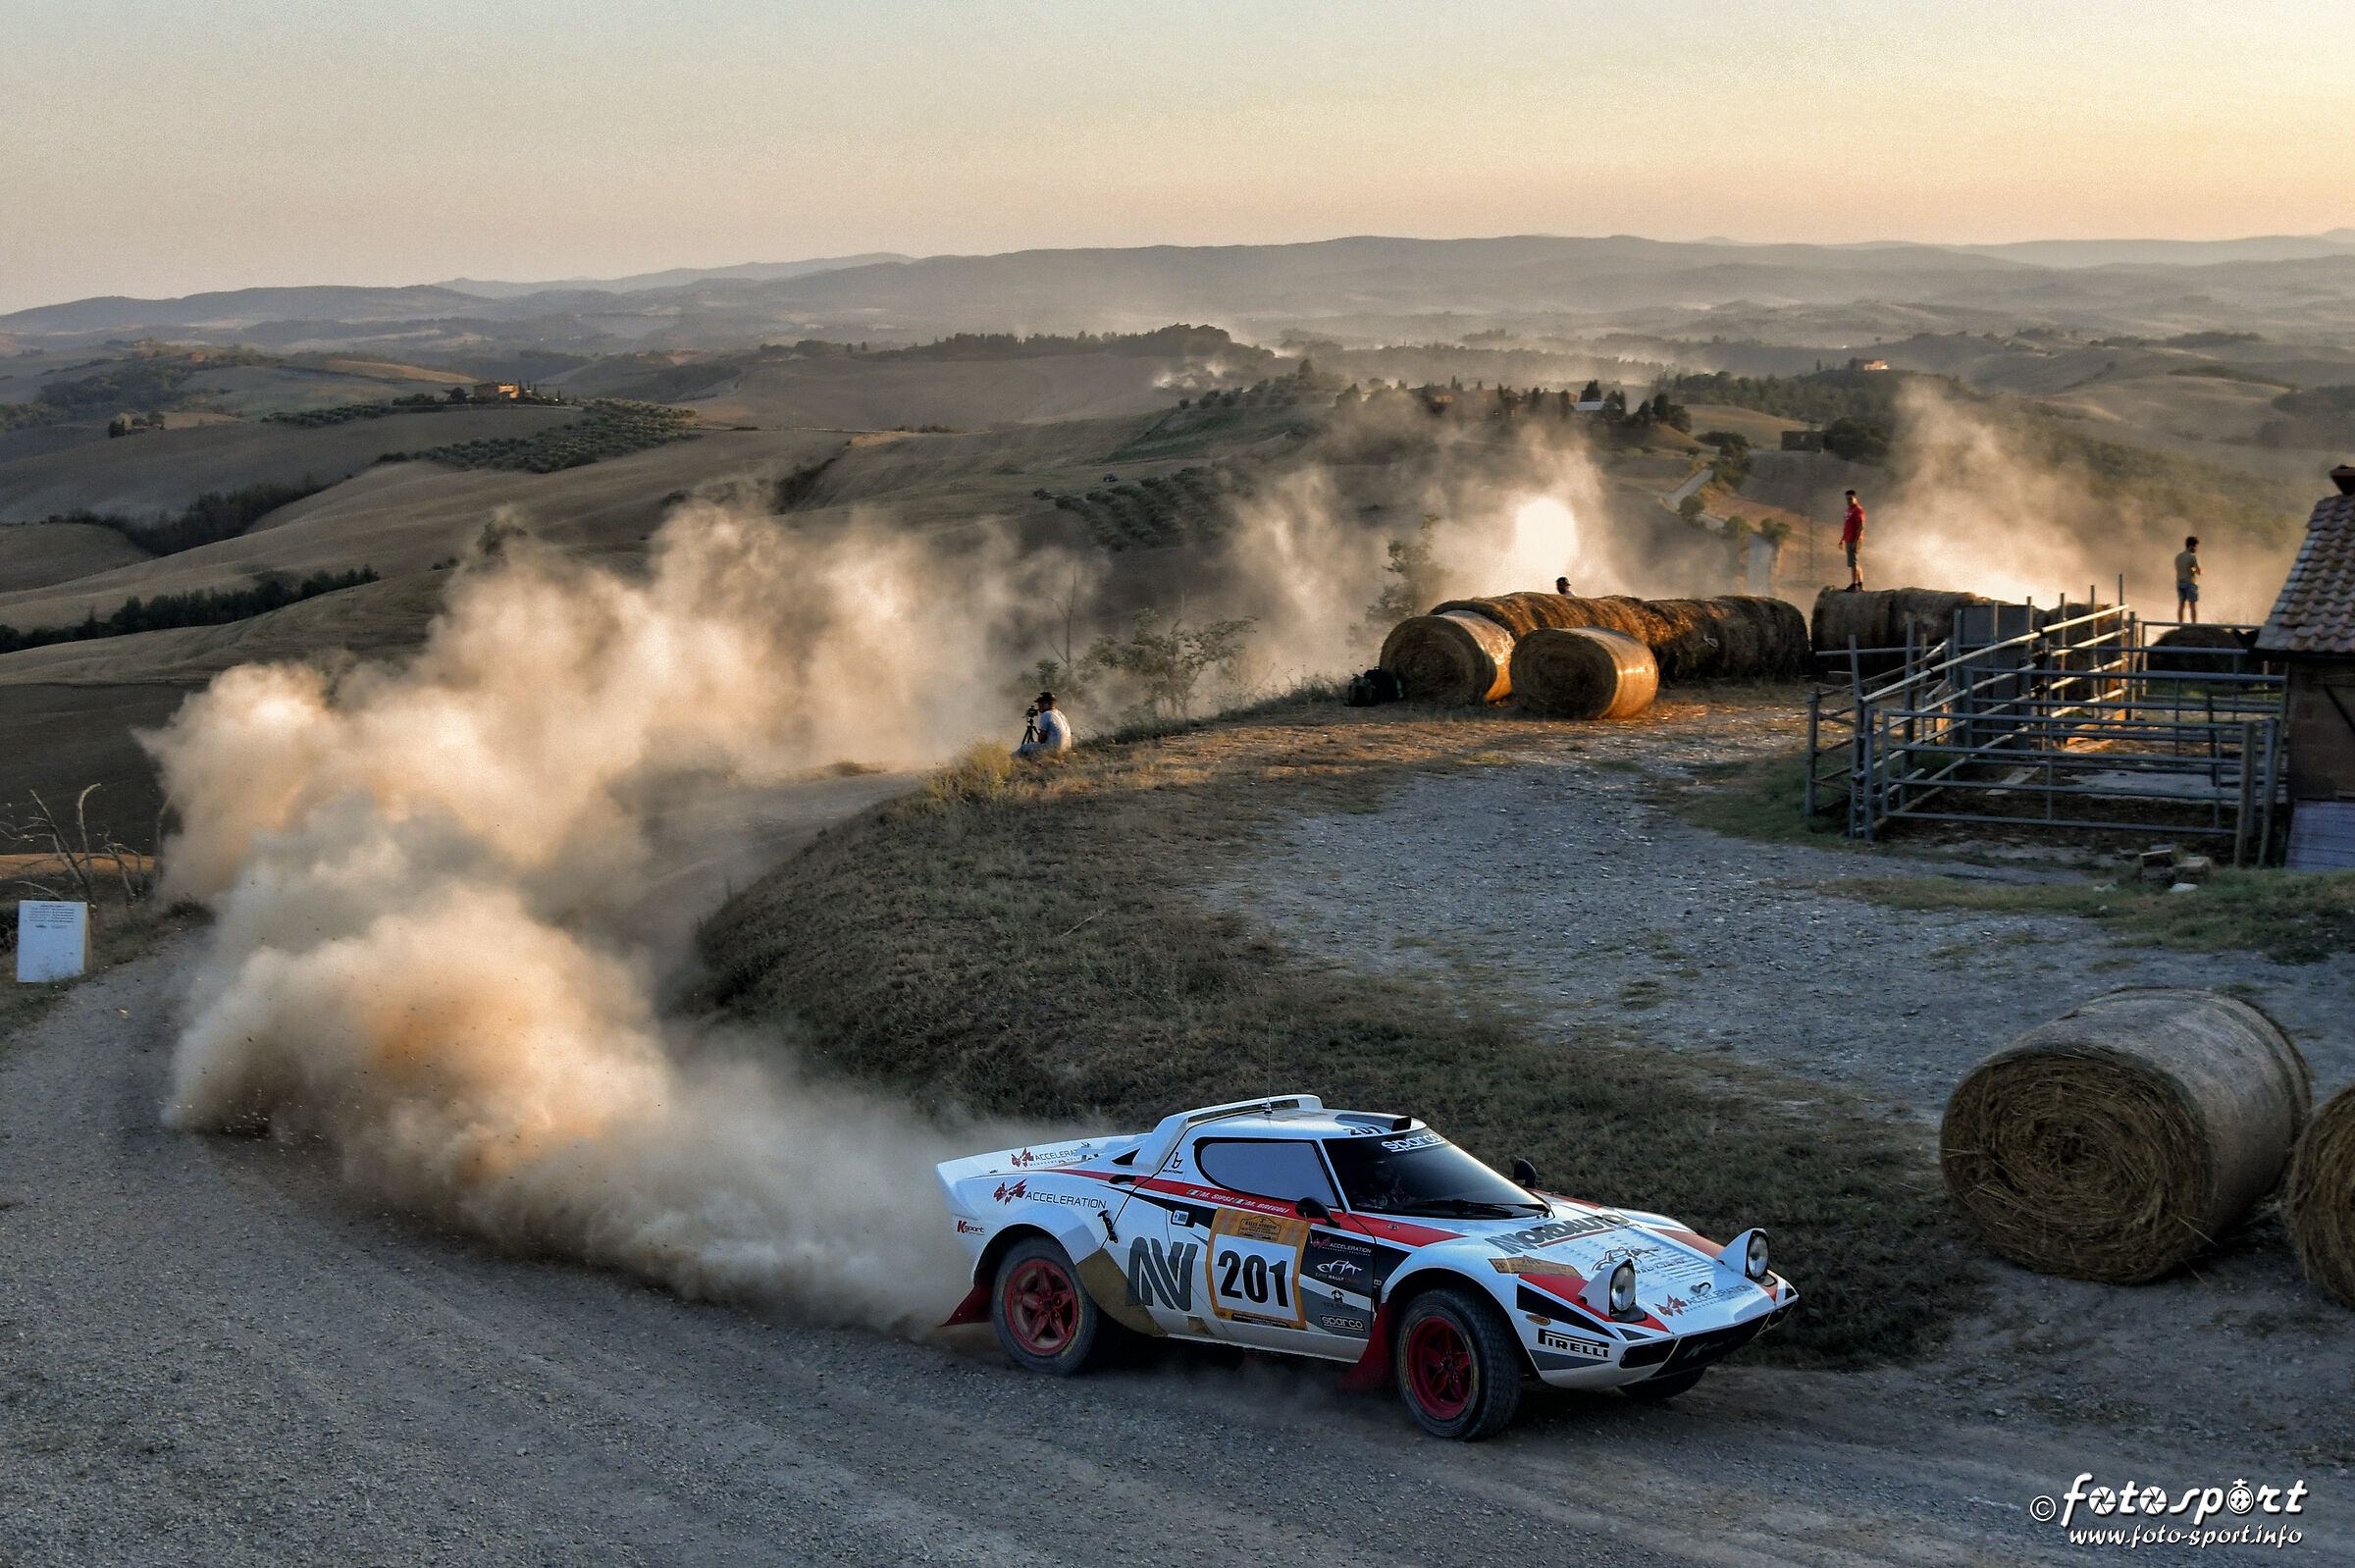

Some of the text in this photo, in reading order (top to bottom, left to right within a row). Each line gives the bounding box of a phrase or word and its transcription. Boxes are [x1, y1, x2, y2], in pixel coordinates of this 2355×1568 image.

[1381, 1133, 1442, 1152] sparco
[1025, 1191, 1107, 1209] ACCELERATION
[1329, 1242, 1372, 1254] ACCELERATION
[1217, 1250, 1289, 1308] 201
[1321, 1316, 1364, 1329] sparco
[1539, 1328, 1609, 1358] PIRELLI
